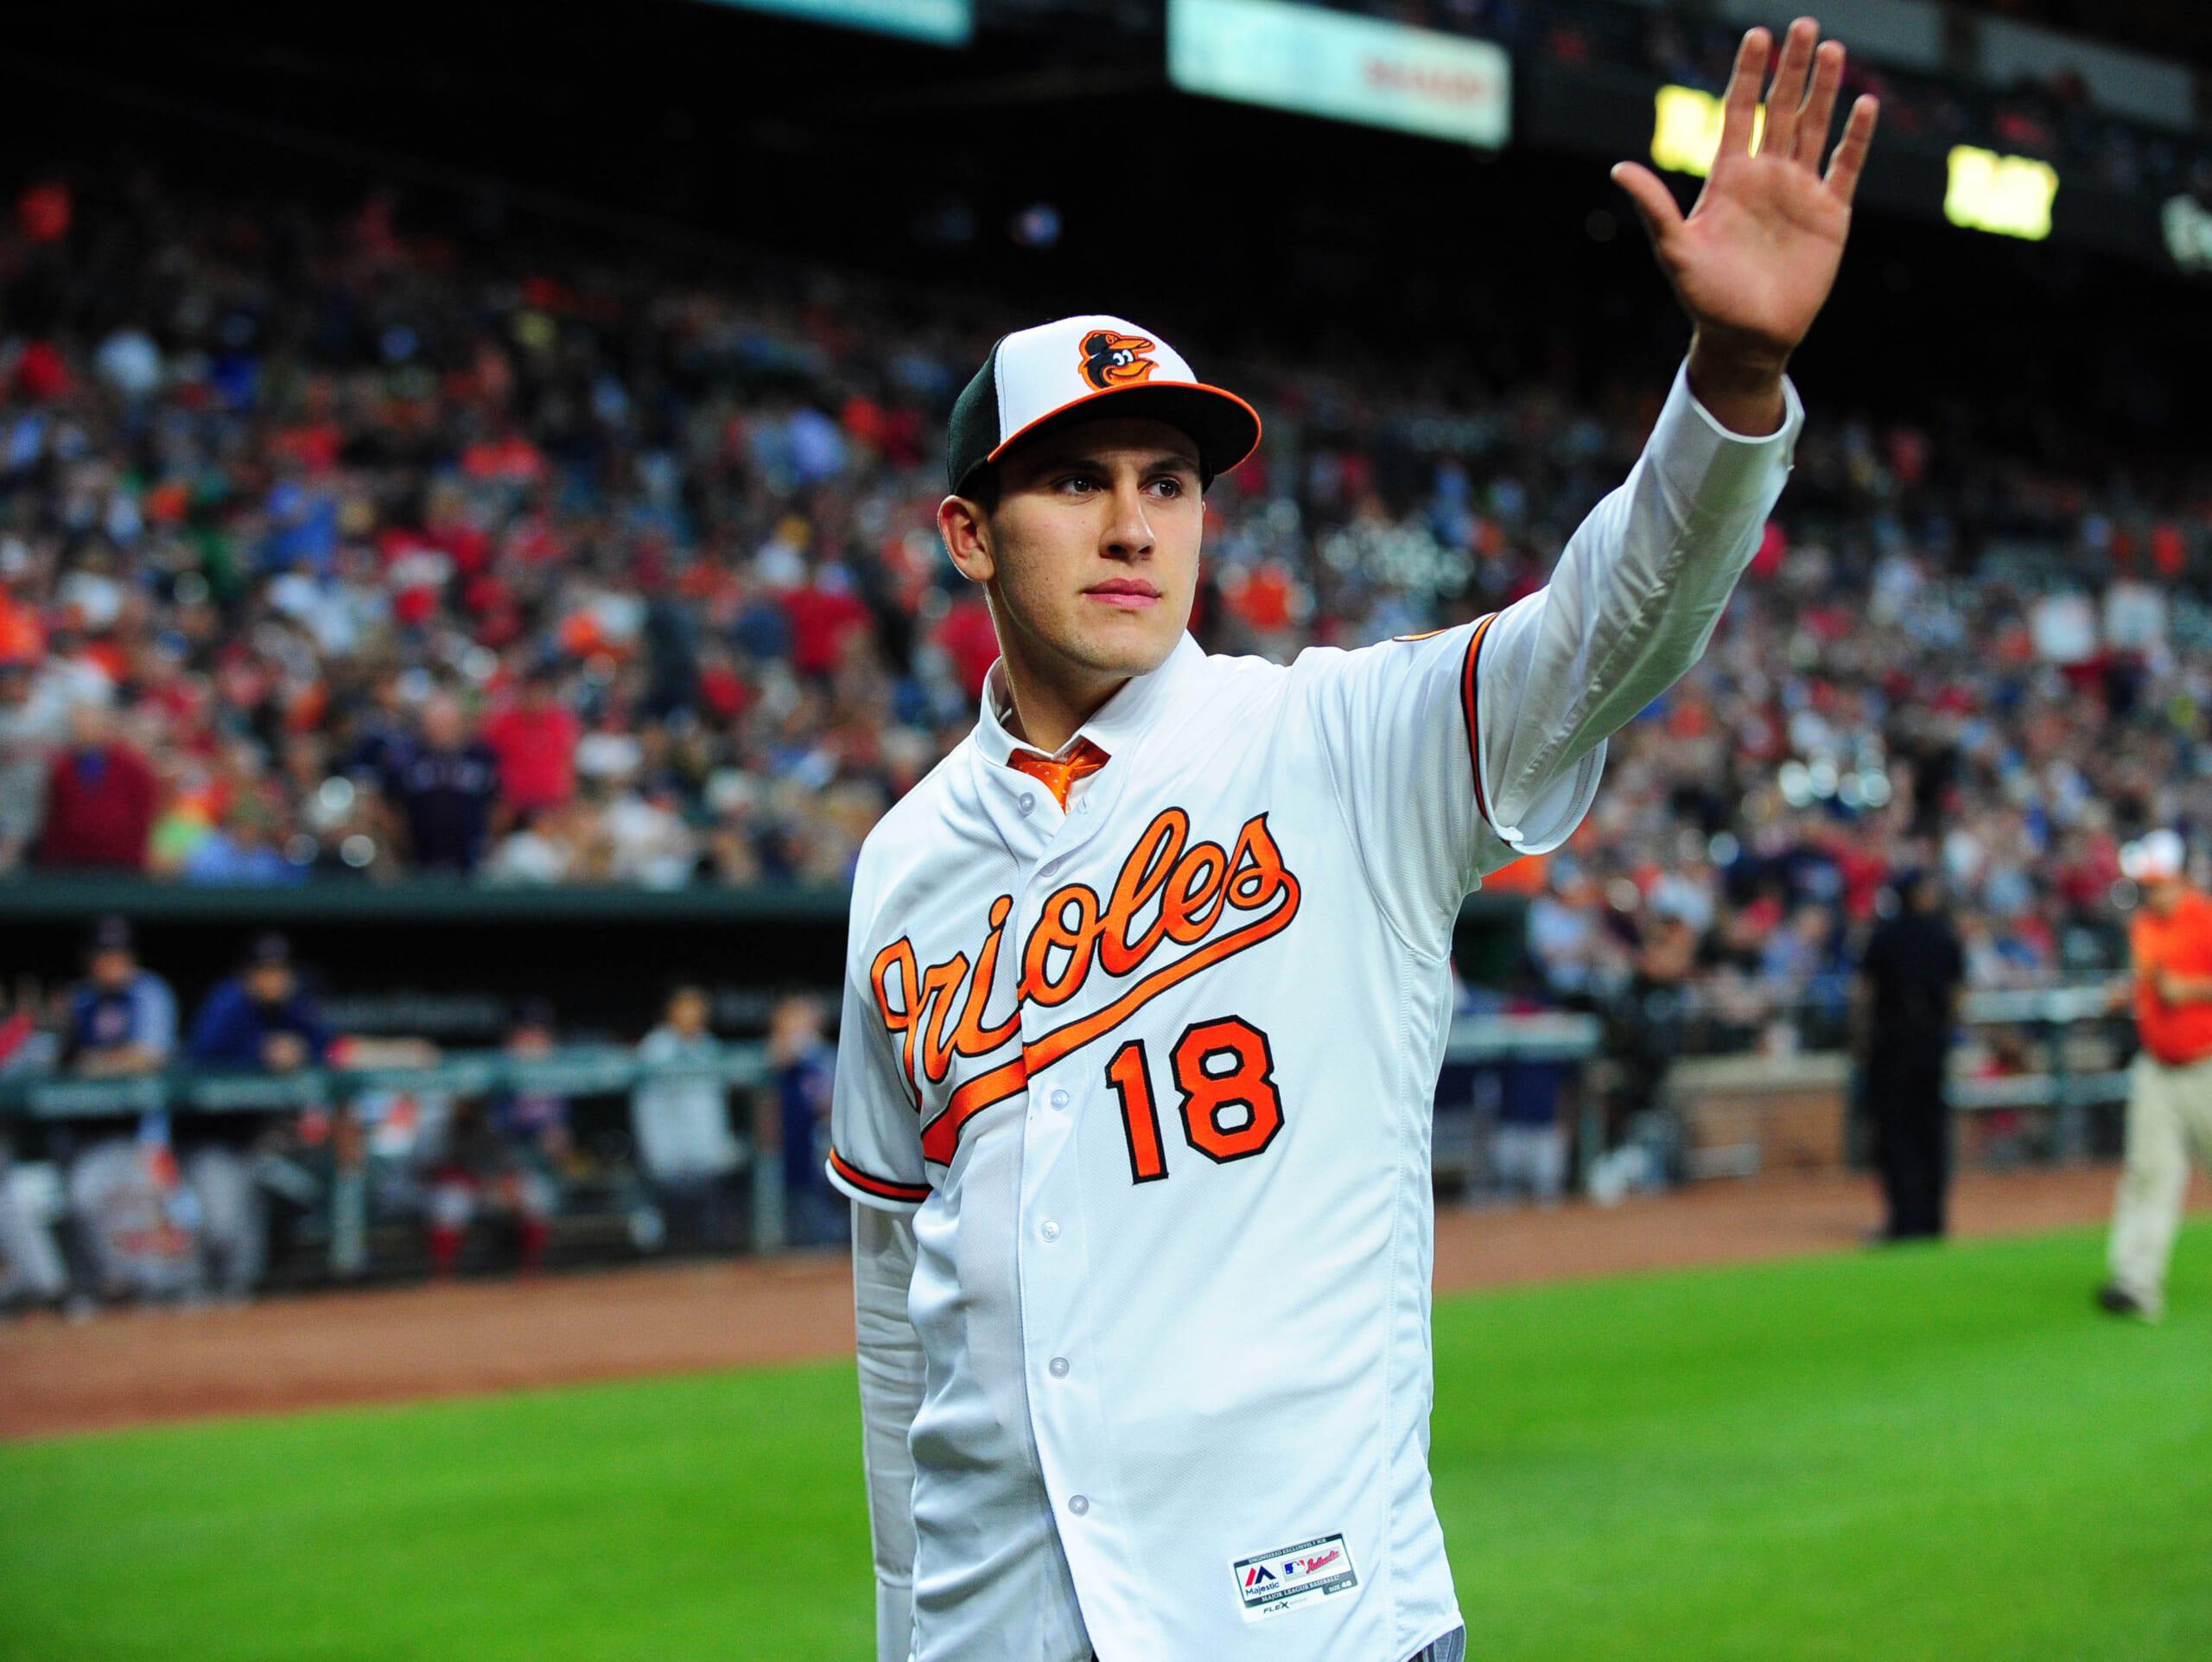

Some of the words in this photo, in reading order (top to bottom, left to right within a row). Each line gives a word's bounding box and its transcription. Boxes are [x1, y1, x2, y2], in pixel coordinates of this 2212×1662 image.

[1105, 1015, 1286, 1185] 18
[1245, 1581, 1280, 1596] Majestic
[1262, 1591, 1283, 1602] MAJOR
[1283, 1583, 1309, 1596] LEAGUE
[1263, 1601, 1290, 1614] FLEX
